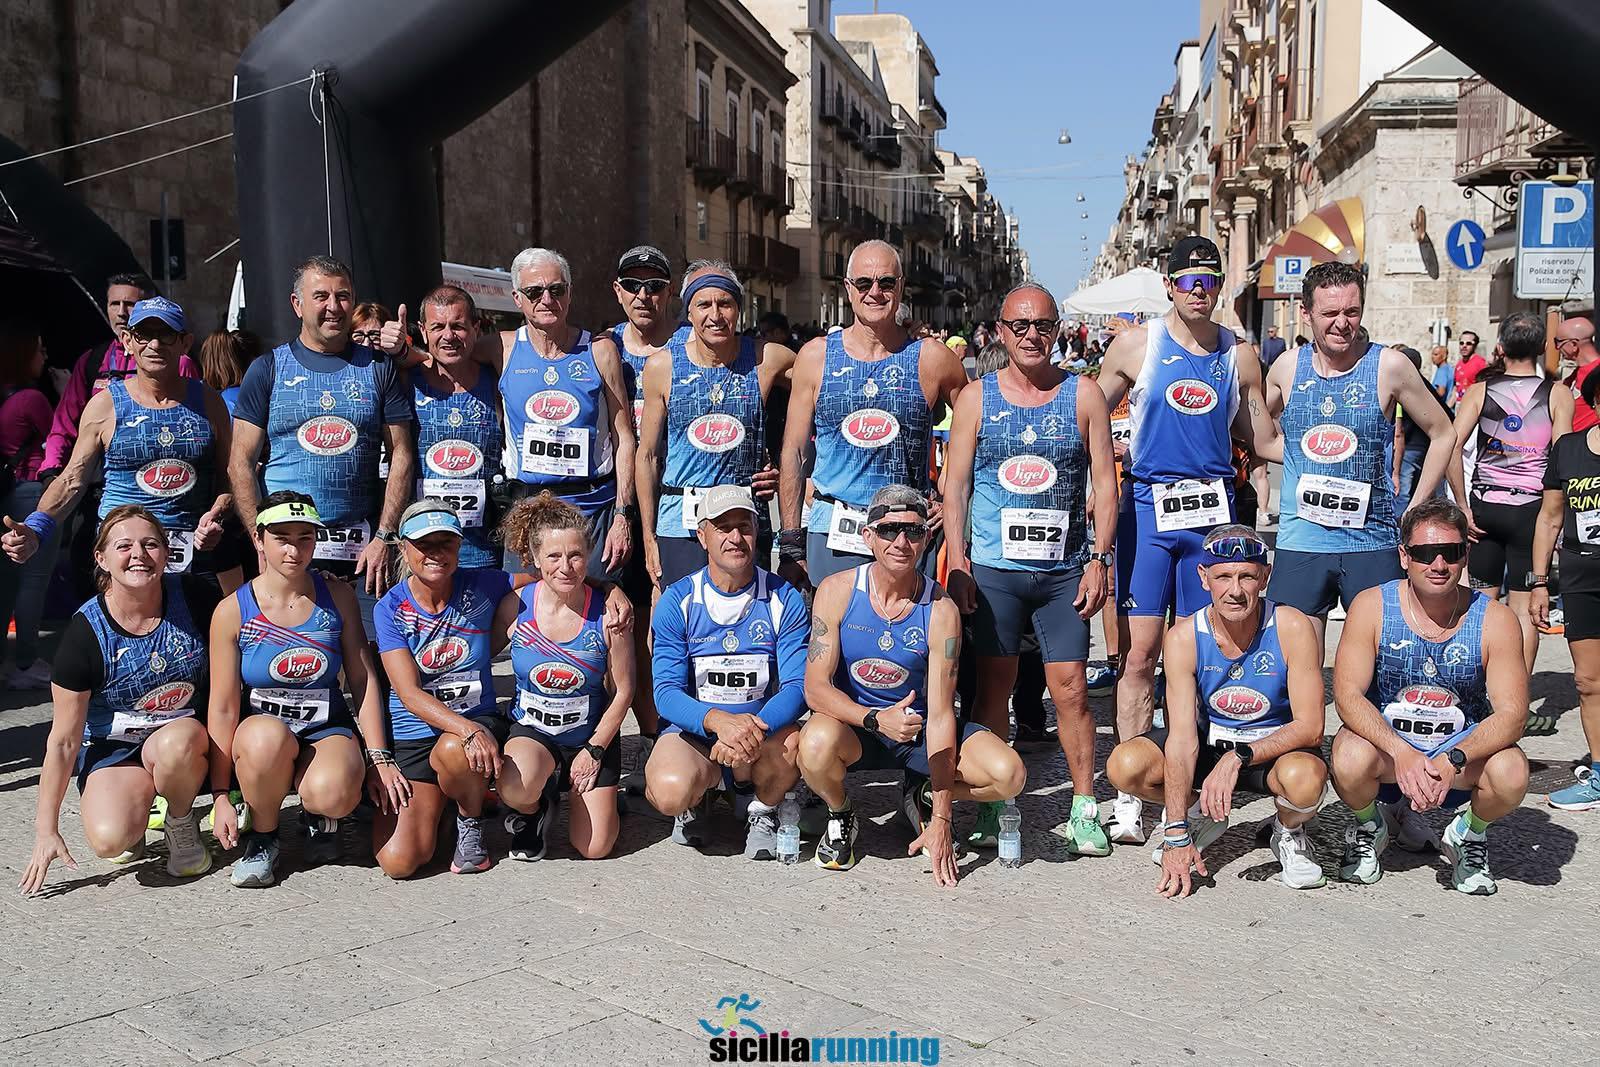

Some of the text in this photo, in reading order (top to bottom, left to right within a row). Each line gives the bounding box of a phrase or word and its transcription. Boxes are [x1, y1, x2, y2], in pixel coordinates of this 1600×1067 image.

[1540, 187, 1587, 245] P
[1288, 260, 1298, 273] P
[1529, 267, 1554, 275] Polizia
[1176, 384, 1208, 405] Sigel
[537, 397, 570, 417] Sigel
[310, 422, 348, 445] Sigel
[700, 420, 735, 443] Sigel
[853, 415, 889, 437] Sigel
[529, 440, 580, 459] 060
[1312, 431, 1348, 453] Sigel
[438, 447, 474, 467] Sigel
[151, 466, 185, 488] Sigel
[1010, 461, 1046, 484] Sigel
[1163, 493, 1220, 513] 058
[1303, 490, 1360, 511] 066
[316, 529, 363, 543] 054
[1009, 525, 1062, 543] 052
[690, 636, 717, 644] macron
[427, 642, 460, 666] Sigel
[282, 654, 319, 676] Sigel
[860, 663, 896, 681] Sigel
[542, 668, 575, 689] Sigel
[708, 672, 757, 688] 061
[261, 701, 318, 721] 057
[1222, 693, 1260, 715] Sigel
[527, 707, 581, 727] 065
[1392, 718, 1456, 736] 064
